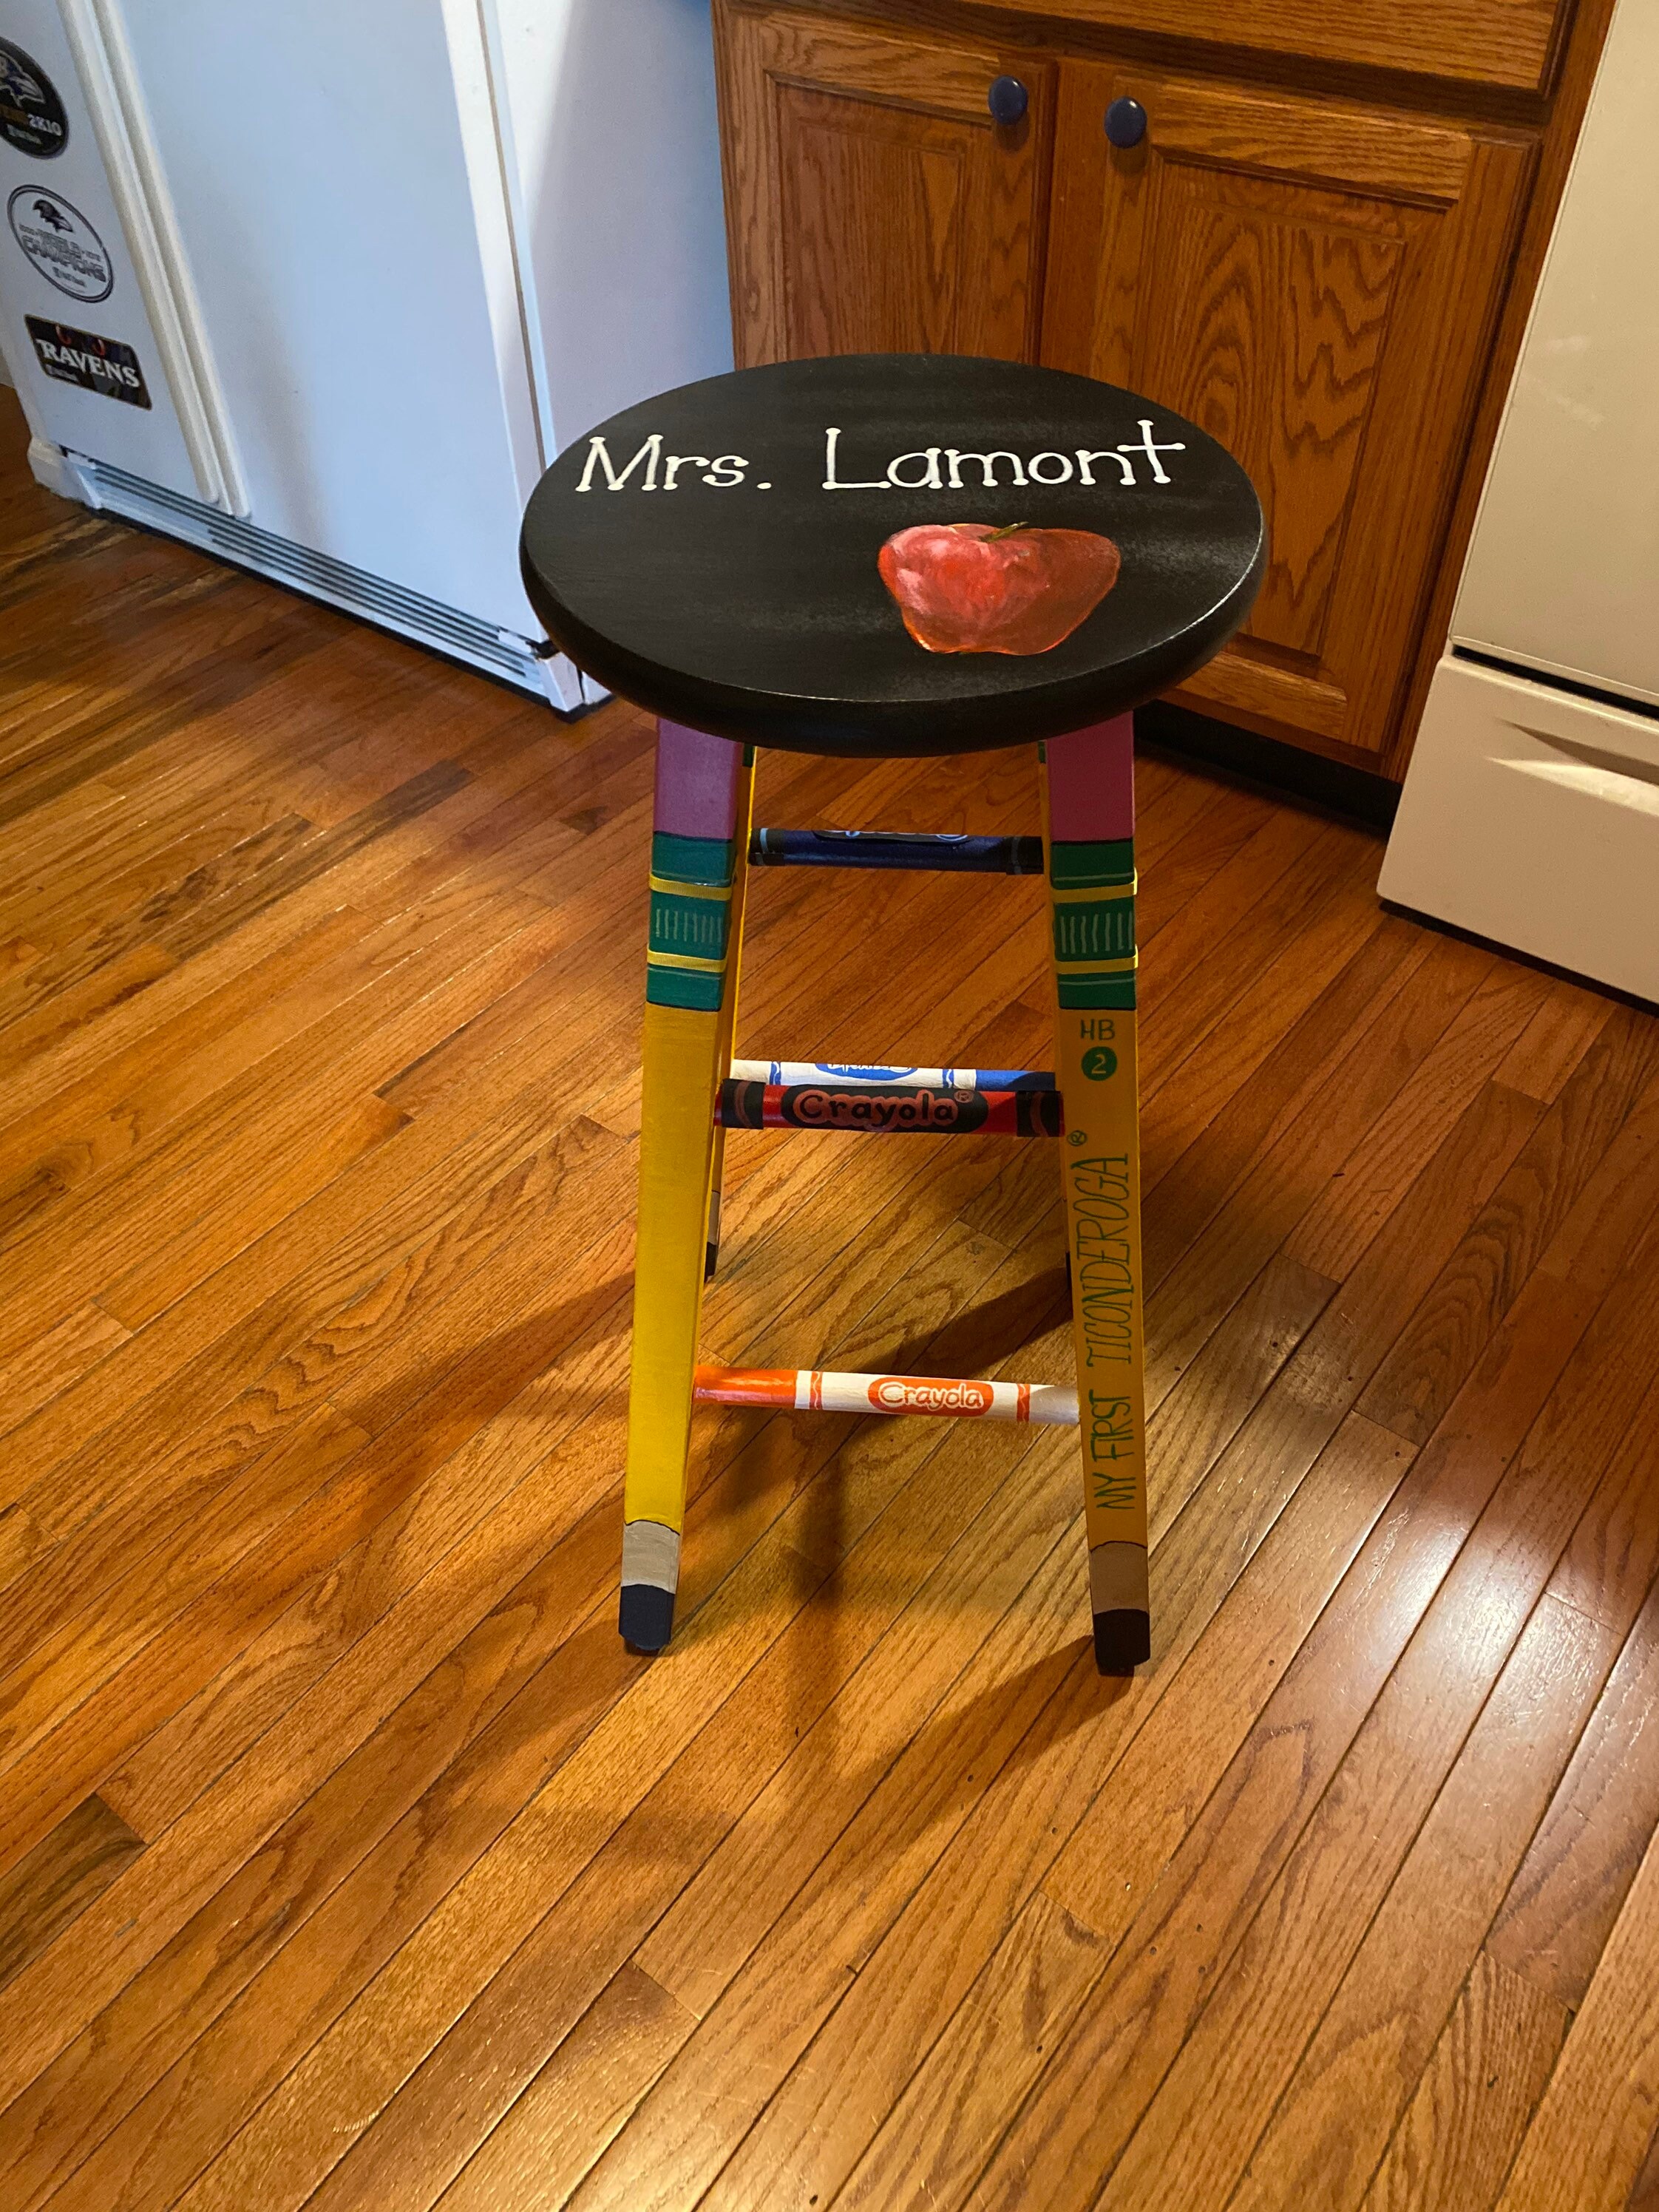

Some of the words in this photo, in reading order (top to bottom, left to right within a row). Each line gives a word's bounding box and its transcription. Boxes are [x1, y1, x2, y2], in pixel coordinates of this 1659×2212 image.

[35, 338, 140, 388] RAVENS
[575, 434, 772, 492] Mrs.
[822, 419, 1186, 491] Lamont
[1080, 1019, 1115, 1040] HB
[1090, 1054, 1107, 1074] 2
[878, 1381, 984, 1411] Crayola
[1088, 1388, 1134, 1462] FIRST
[1093, 1472, 1136, 1510] MY
